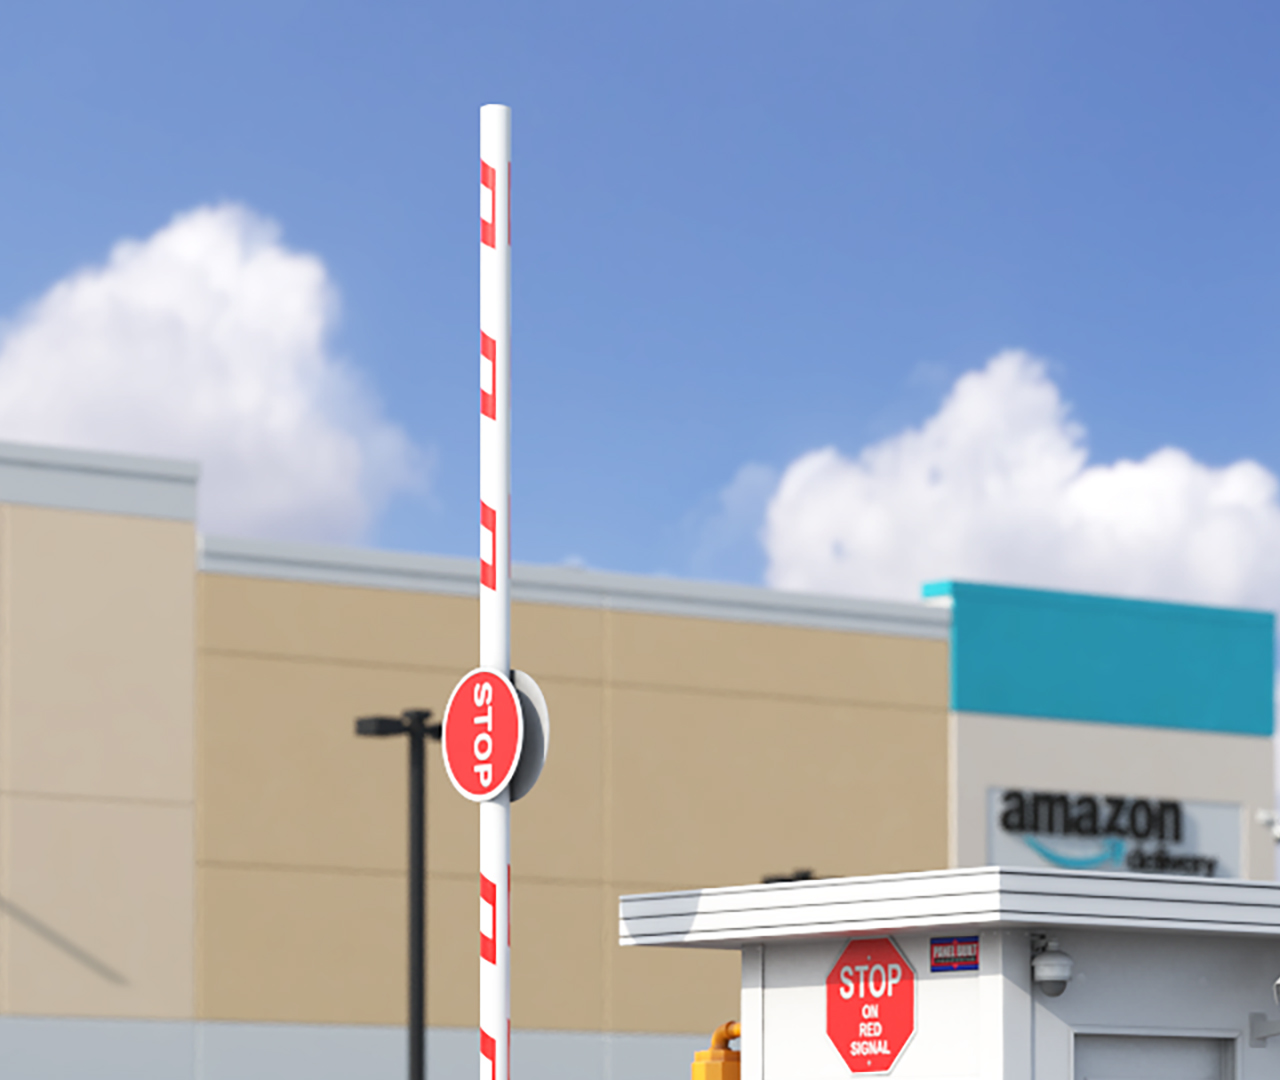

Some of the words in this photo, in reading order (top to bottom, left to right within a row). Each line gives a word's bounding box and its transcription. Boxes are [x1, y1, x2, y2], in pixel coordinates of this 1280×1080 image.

[473, 681, 493, 788] STOP
[999, 789, 1183, 843] amazon
[840, 963, 902, 1000] STOP
[862, 1004, 879, 1019] ON
[859, 1022, 883, 1037] RED
[850, 1040, 891, 1056] SIGNAL
